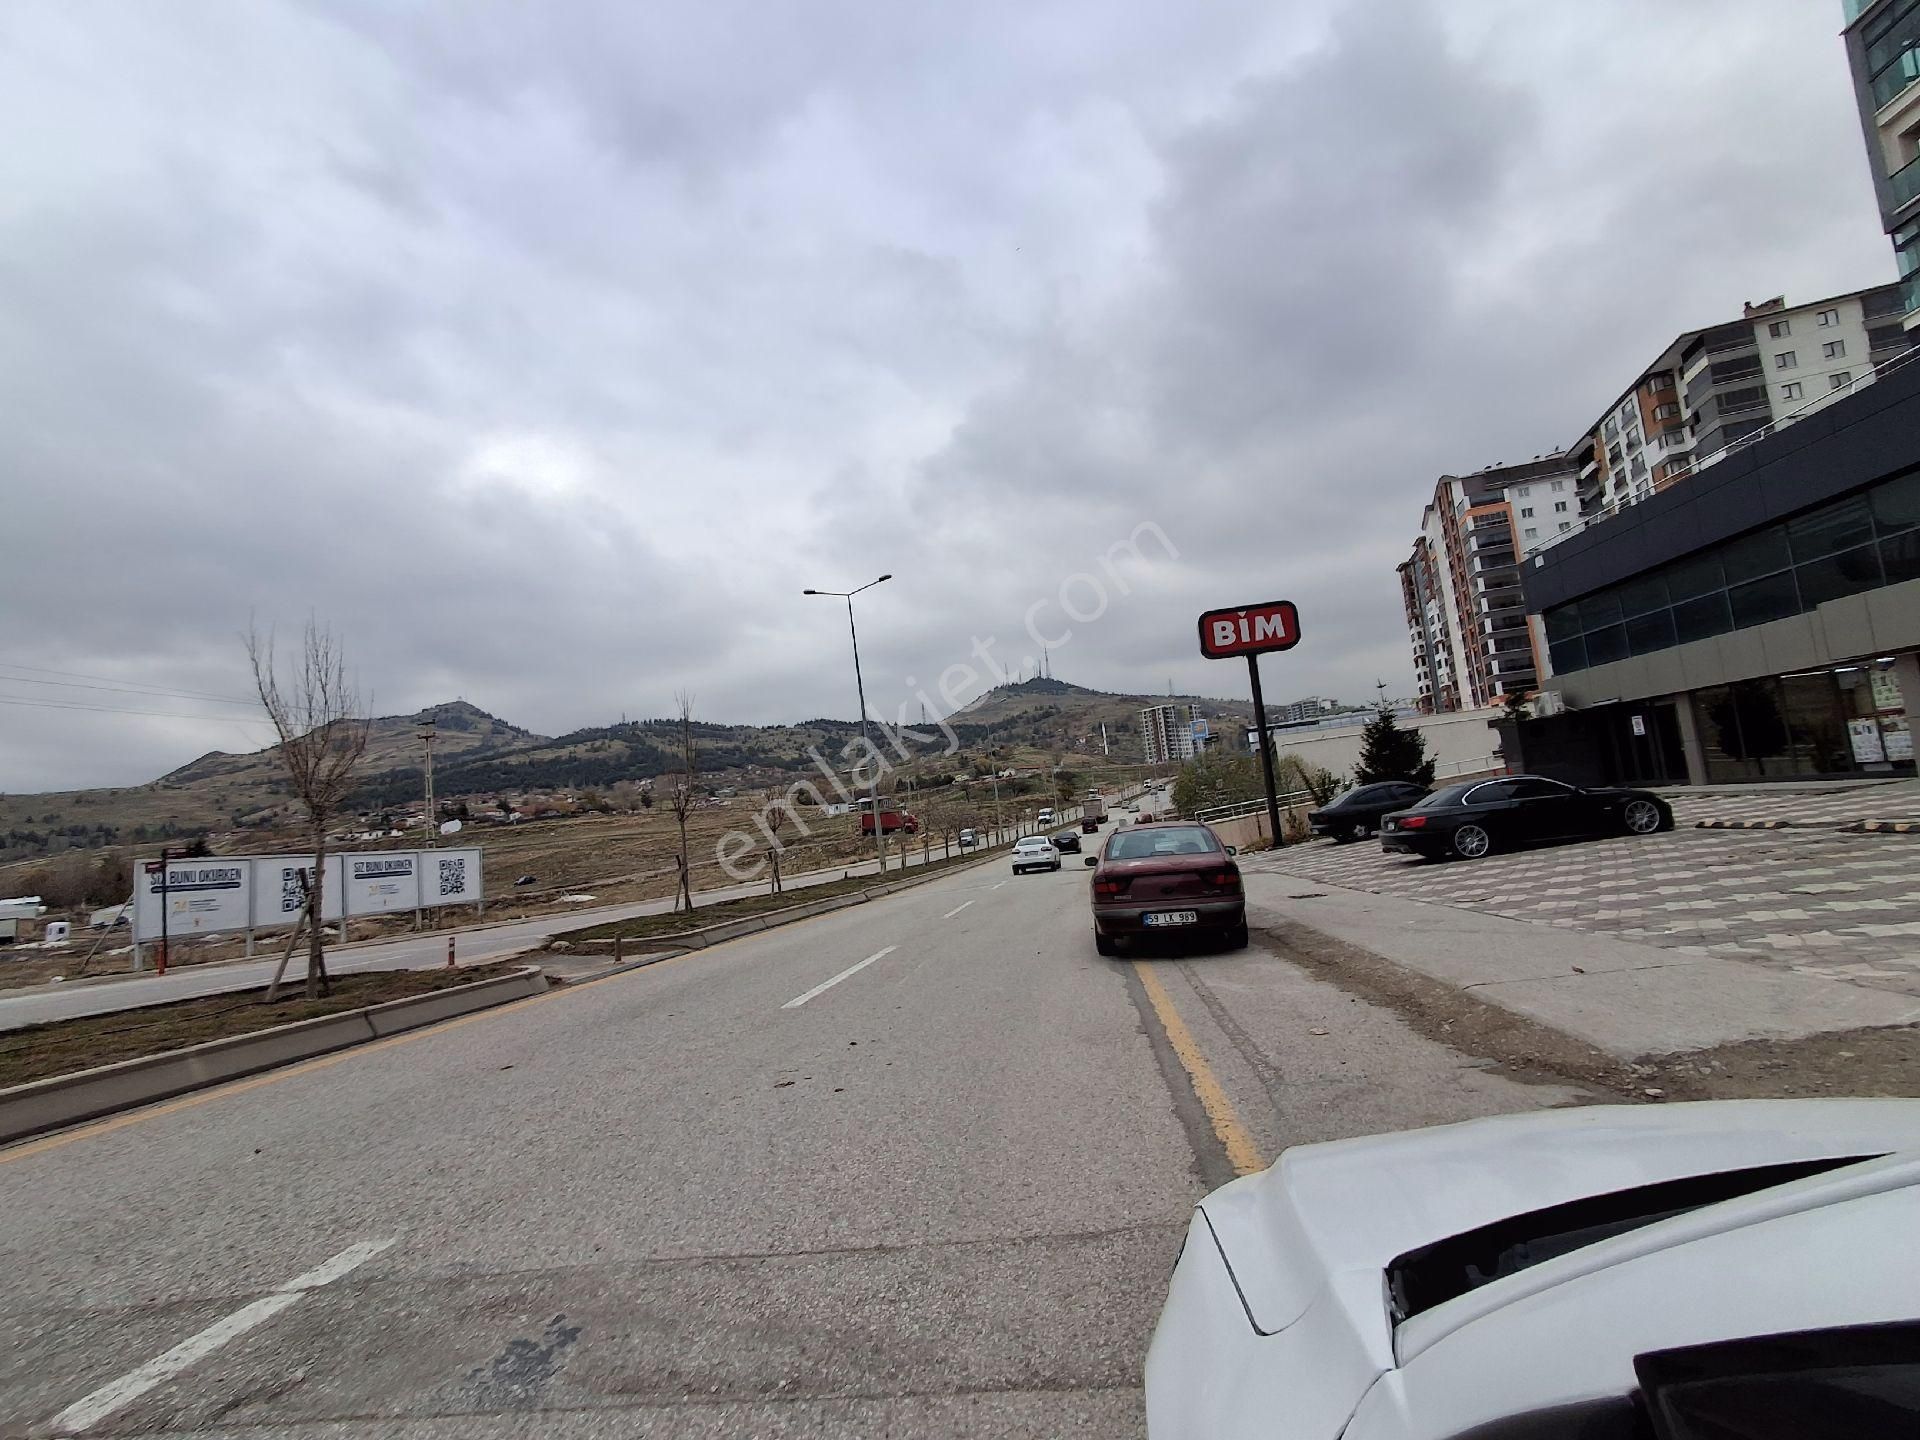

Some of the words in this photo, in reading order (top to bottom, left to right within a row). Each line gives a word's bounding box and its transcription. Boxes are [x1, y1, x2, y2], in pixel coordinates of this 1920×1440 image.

[1213, 611, 1286, 646] BİM
[366, 861, 383, 872] BUNU
[385, 859, 412, 870] OKURKEN
[169, 870, 197, 884] BUNU
[199, 869, 242, 882] OKURKEN
